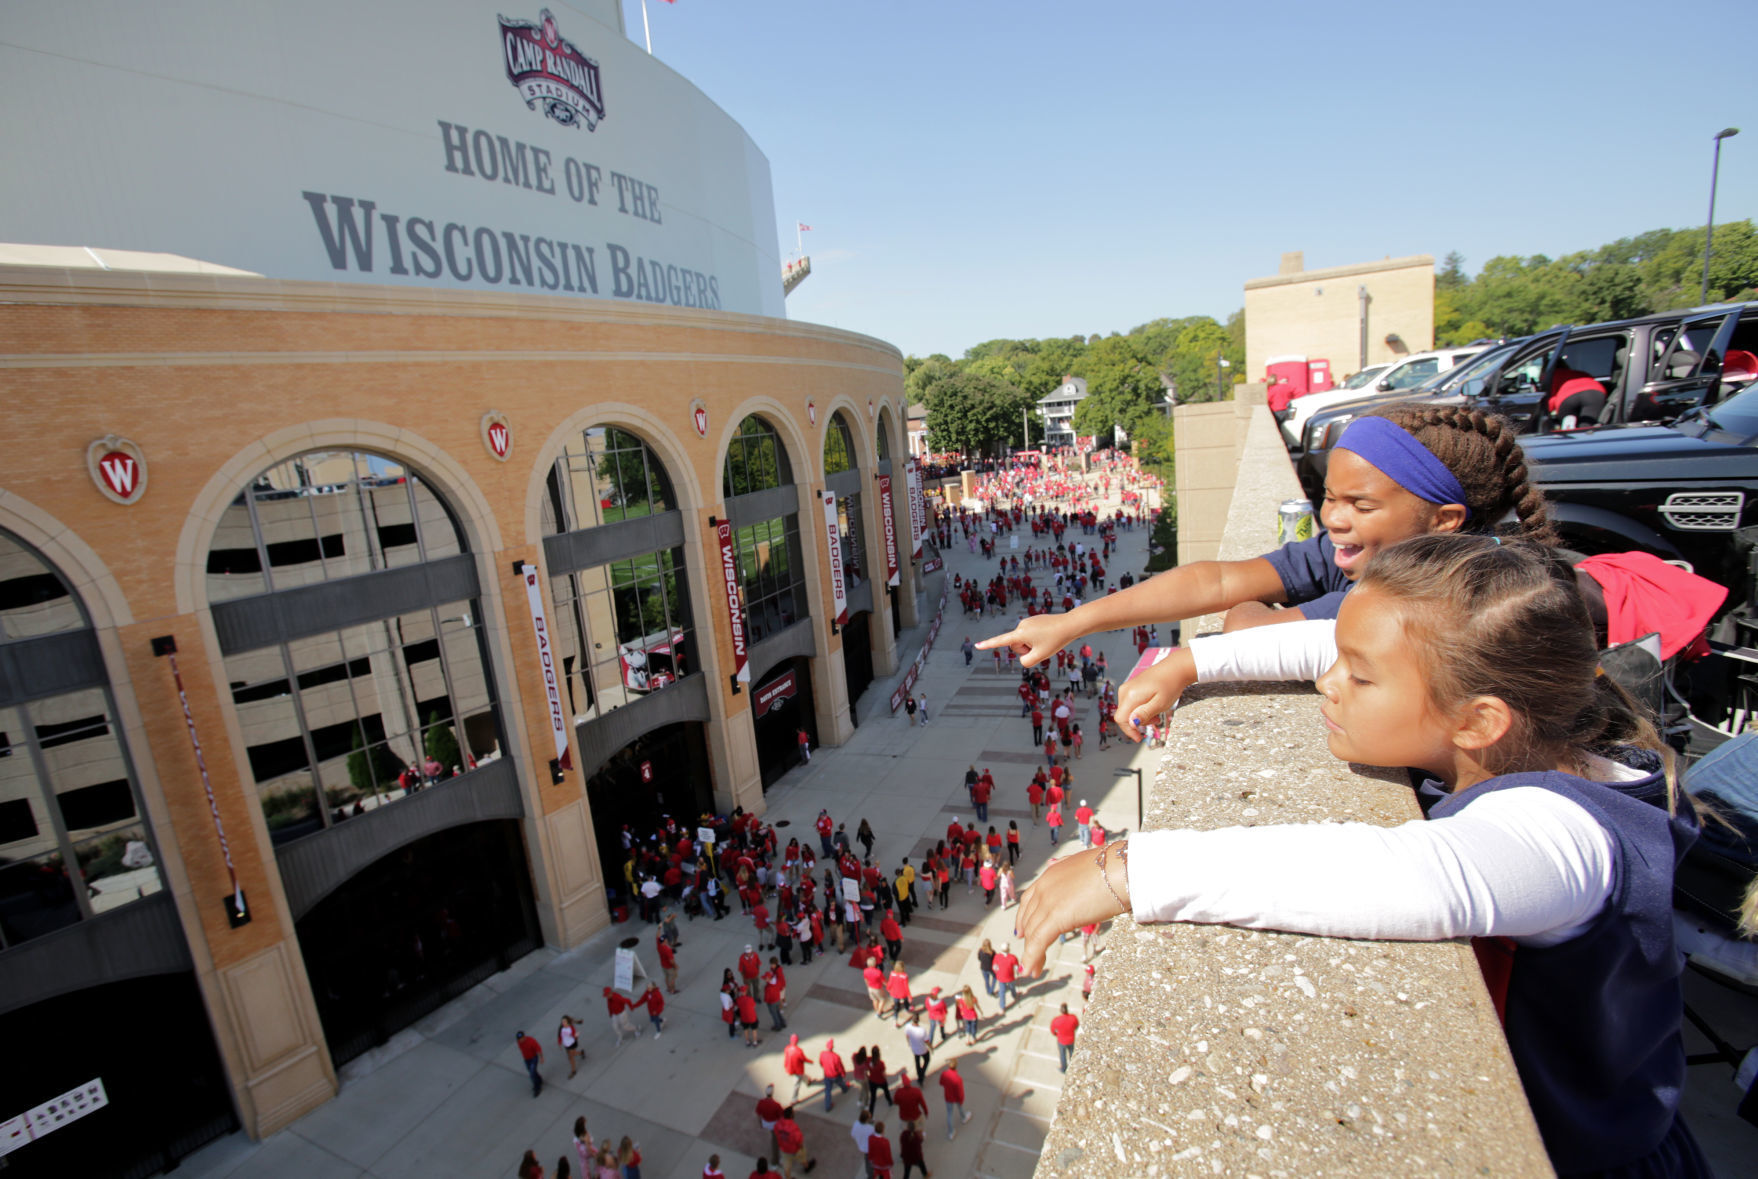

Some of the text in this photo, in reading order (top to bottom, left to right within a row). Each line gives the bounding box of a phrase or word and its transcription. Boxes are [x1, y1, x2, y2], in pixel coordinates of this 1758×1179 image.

[506, 31, 602, 111] CAMP RANDALL
[527, 84, 591, 116] STADIUM
[437, 119, 662, 225] HOME OF THE
[301, 190, 722, 311] WISCONSIN BADGERS
[490, 428, 507, 453] W
[695, 413, 706, 432] W
[100, 458, 134, 493] W
[828, 524, 844, 600] BADGERS
[881, 492, 897, 568] WISCONSIN
[721, 544, 746, 656] WISCONSIN
[535, 616, 564, 732] BADGERS
